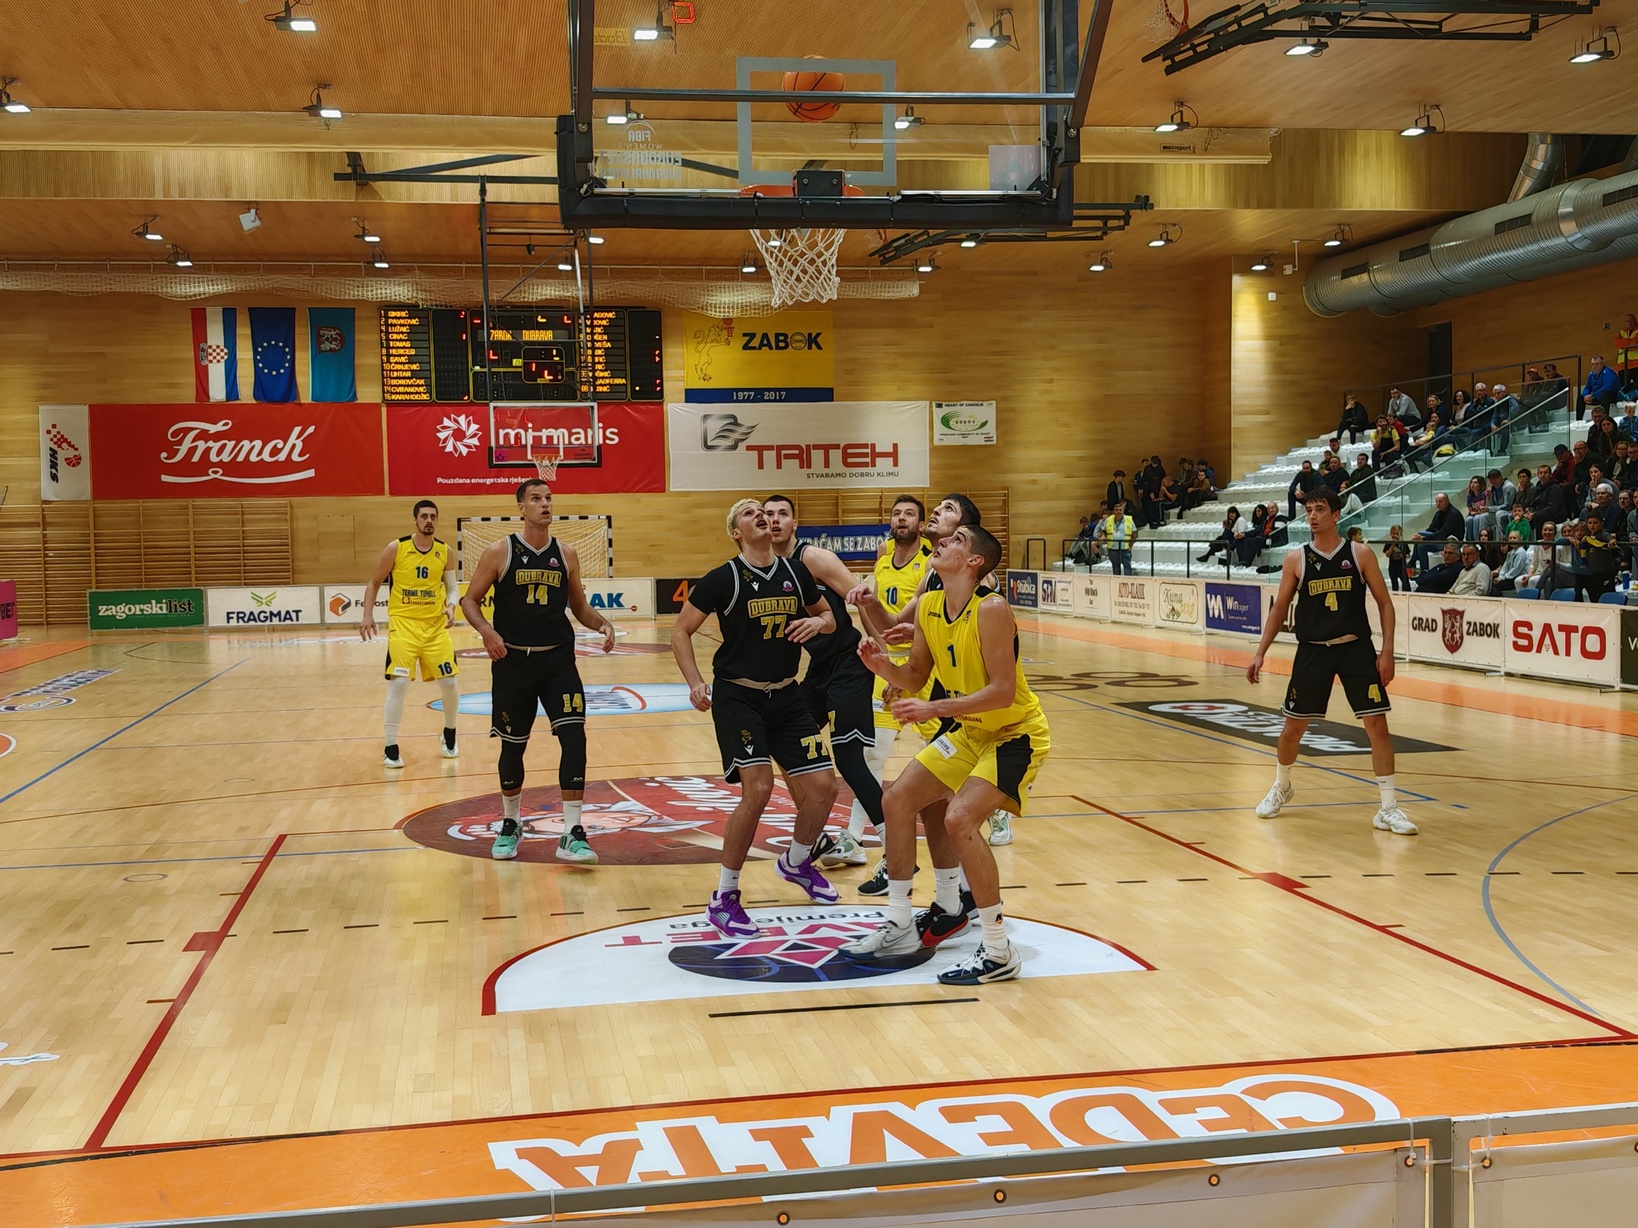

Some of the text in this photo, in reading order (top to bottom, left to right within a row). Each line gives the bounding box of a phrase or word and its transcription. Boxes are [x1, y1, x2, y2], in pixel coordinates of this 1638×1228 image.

[742, 332, 823, 350] ZABOK
[733, 391, 755, 400] 1977
[764, 391, 786, 400] 2017
[160, 419, 316, 465] Franck
[48, 446, 59, 484] HKS
[746, 443, 899, 470] TRITEH
[471, 477, 508, 485] energetska
[415, 565, 429, 579] 16
[517, 570, 561, 586] DUBRAVA
[526, 584, 548, 606] 14
[1310, 577, 1352, 594] DUBRAVA
[885, 586, 898, 606] 10
[1324, 592, 1339, 612] 4
[226, 608, 303, 624] FRAGMAT
[750, 598, 796, 616] DUBRAVA
[760, 614, 788, 640] 77
[1411, 615, 1501, 639] GRAD ZABOK
[1512, 619, 1607, 661] SATO
[947, 643, 957, 668] 1
[437, 661, 453, 676] 16
[562, 692, 584, 713] 14
[1368, 683, 1382, 703] 4
